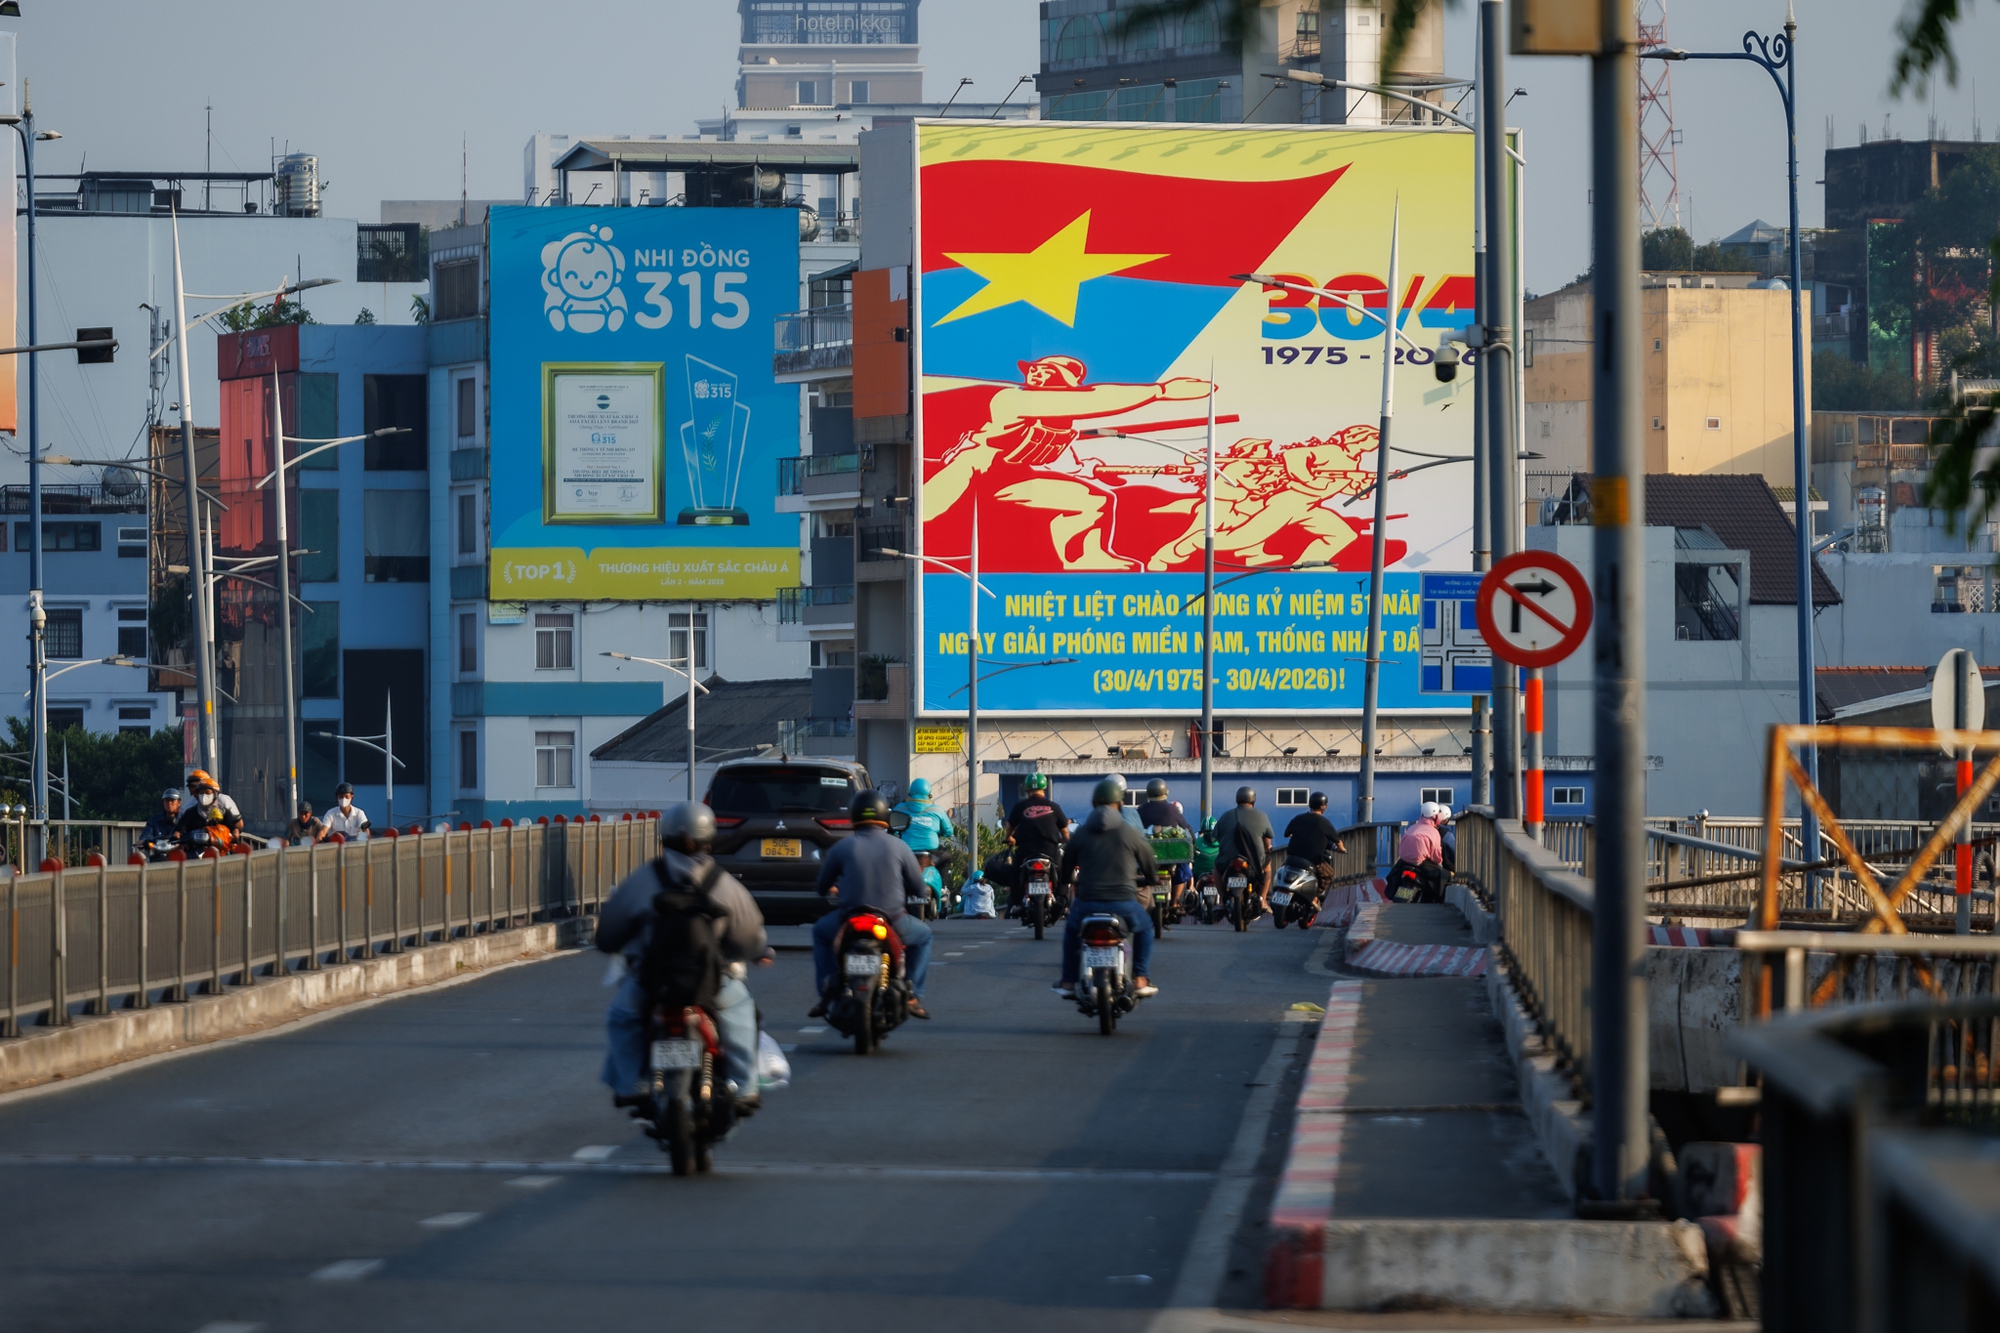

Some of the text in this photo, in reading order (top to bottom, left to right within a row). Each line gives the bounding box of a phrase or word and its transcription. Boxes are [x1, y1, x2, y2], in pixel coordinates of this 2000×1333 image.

[796, 13, 892, 31] hotel nikko
[635, 241, 750, 268] NHI ĐỒNG
[635, 271, 750, 329] 315
[1261, 346, 1348, 366] 1975
[711, 387, 732, 398] 315
[602, 436, 616, 444] 315
[514, 561, 565, 580] TOP 1
[599, 559, 789, 575] THƯƠNG HIỆU XUẤT SẮC CHÂU Á
[1005, 590, 1067, 622] NHIỆT
[1073, 590, 1117, 621] LIỆT
[1123, 589, 1180, 616] CHÀO
[1256, 586, 1283, 616] KỶ
[1289, 589, 1344, 620] NIỆM
[1003, 625, 1046, 655] GIẢI
[1053, 627, 1125, 654] PHÓNG
[1132, 624, 1187, 653] MIỀN
[1256, 622, 1325, 653] THỐNG
[1094, 668, 1204, 694] (30/4/1975
[1226, 667, 1346, 693] 30/4/2026)!
[772, 839, 789, 847] 50E
